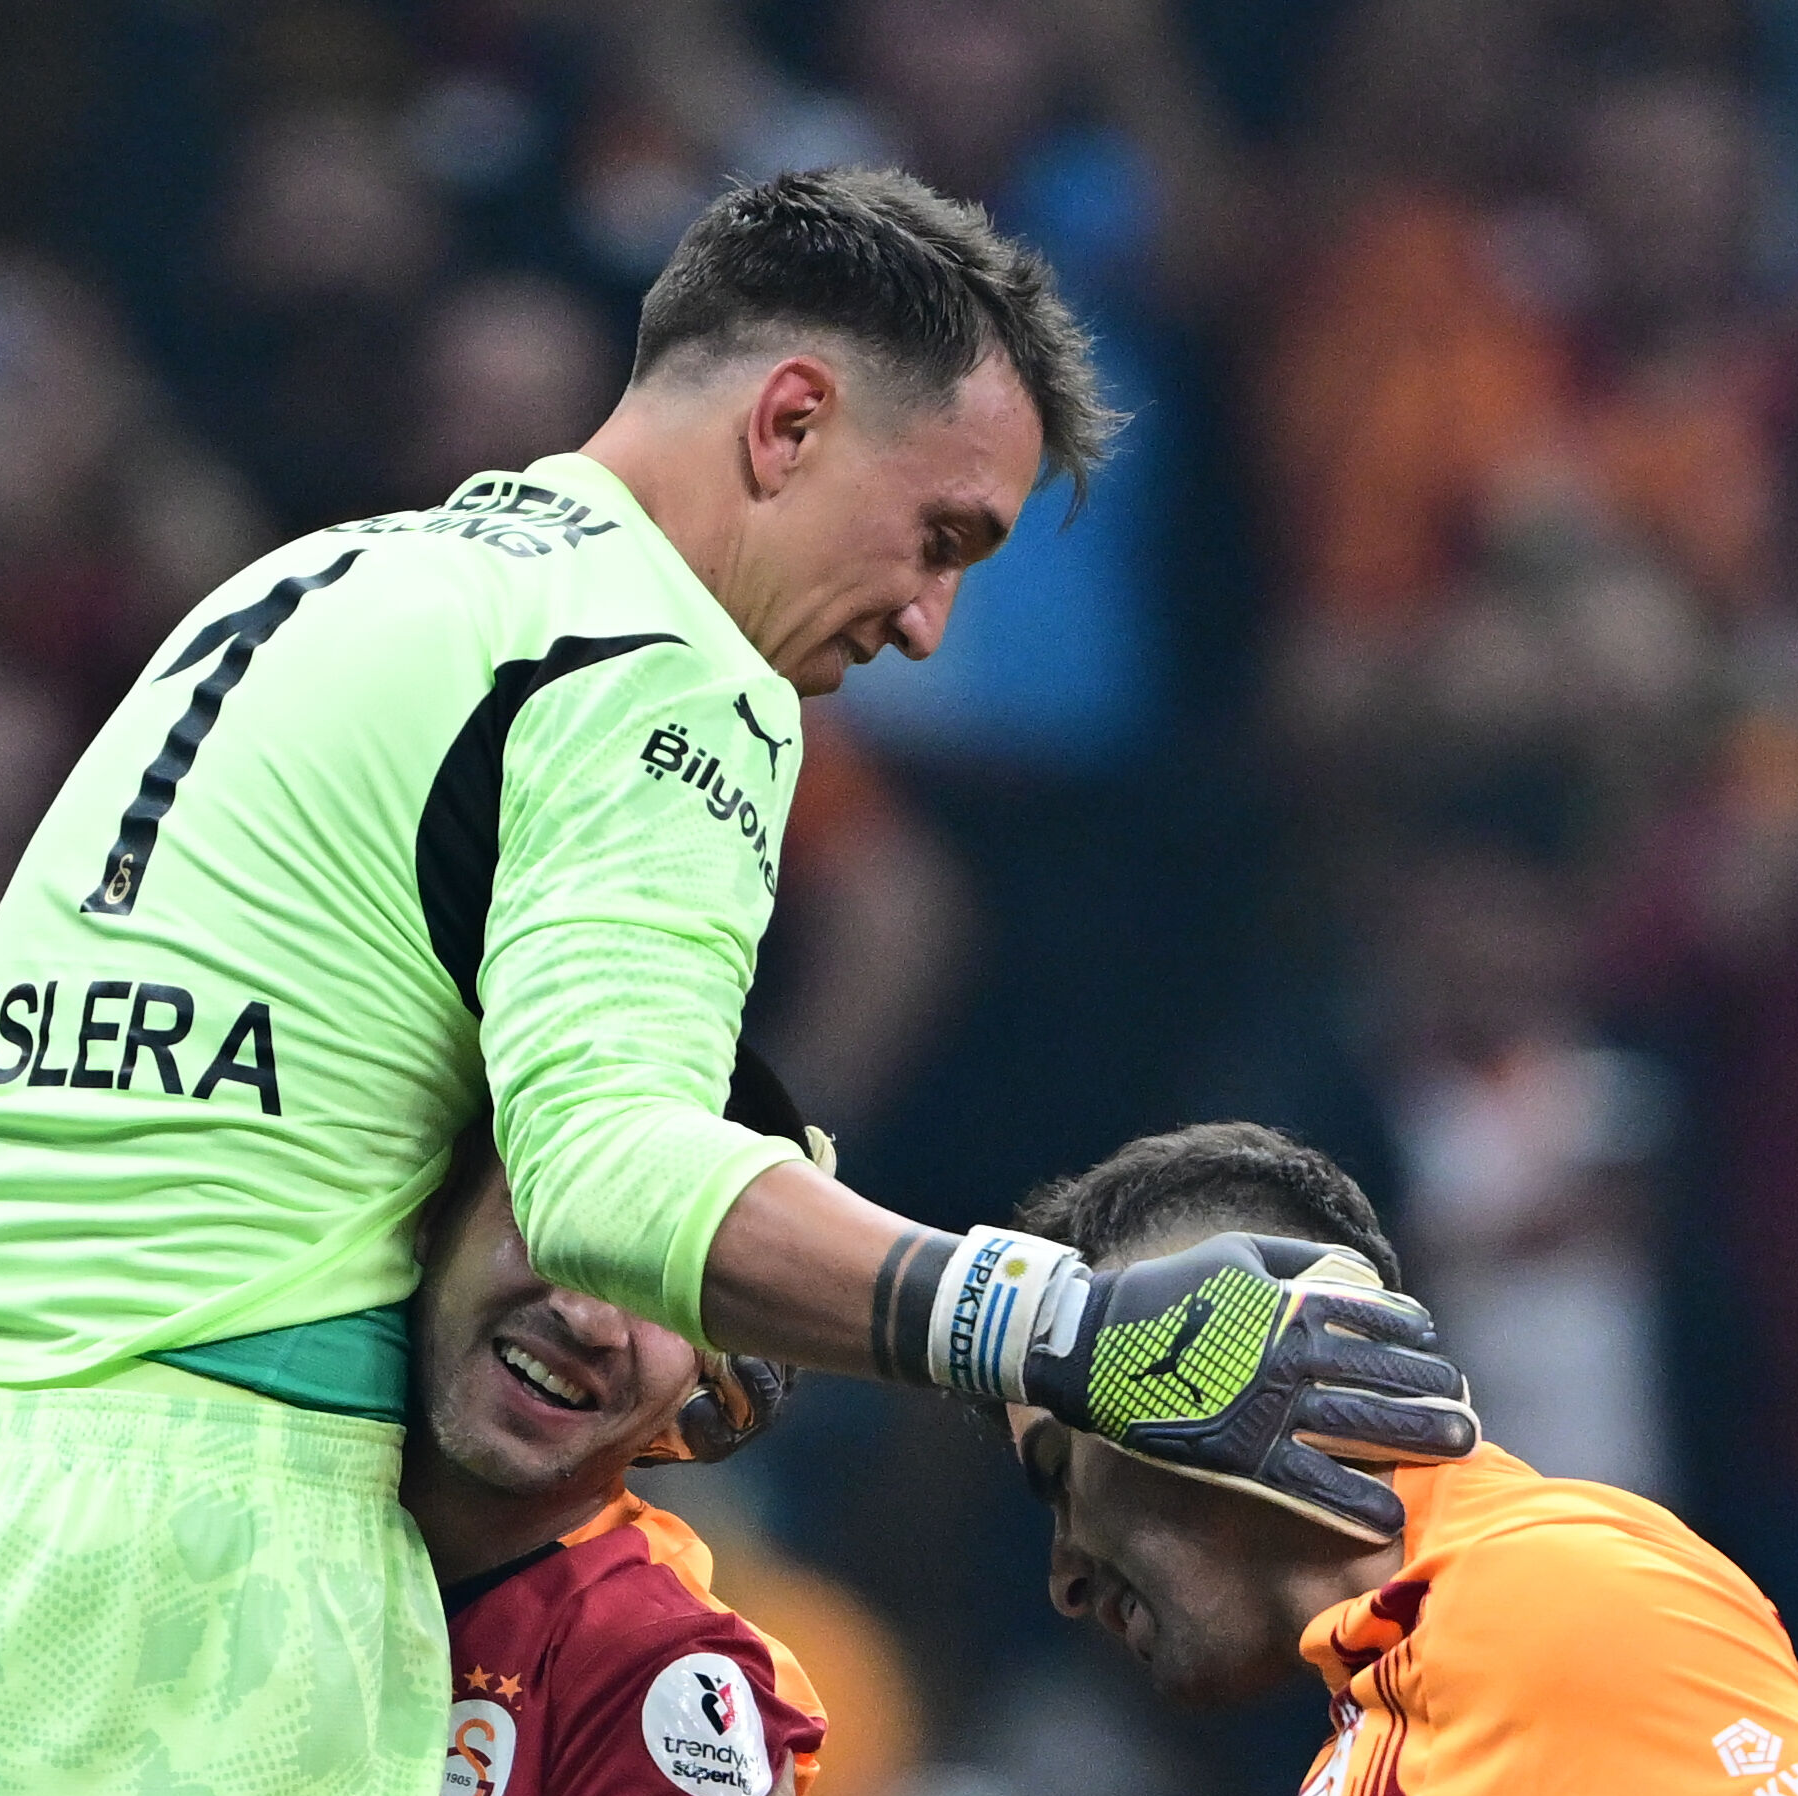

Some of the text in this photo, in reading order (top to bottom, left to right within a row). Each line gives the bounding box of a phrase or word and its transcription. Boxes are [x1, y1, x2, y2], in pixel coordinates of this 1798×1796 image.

[79, 549, 367, 914] 1
[640, 723, 776, 897] Bilyone
[446, 1772, 472, 1787] 1905
[663, 1735, 760, 1777] trendy
